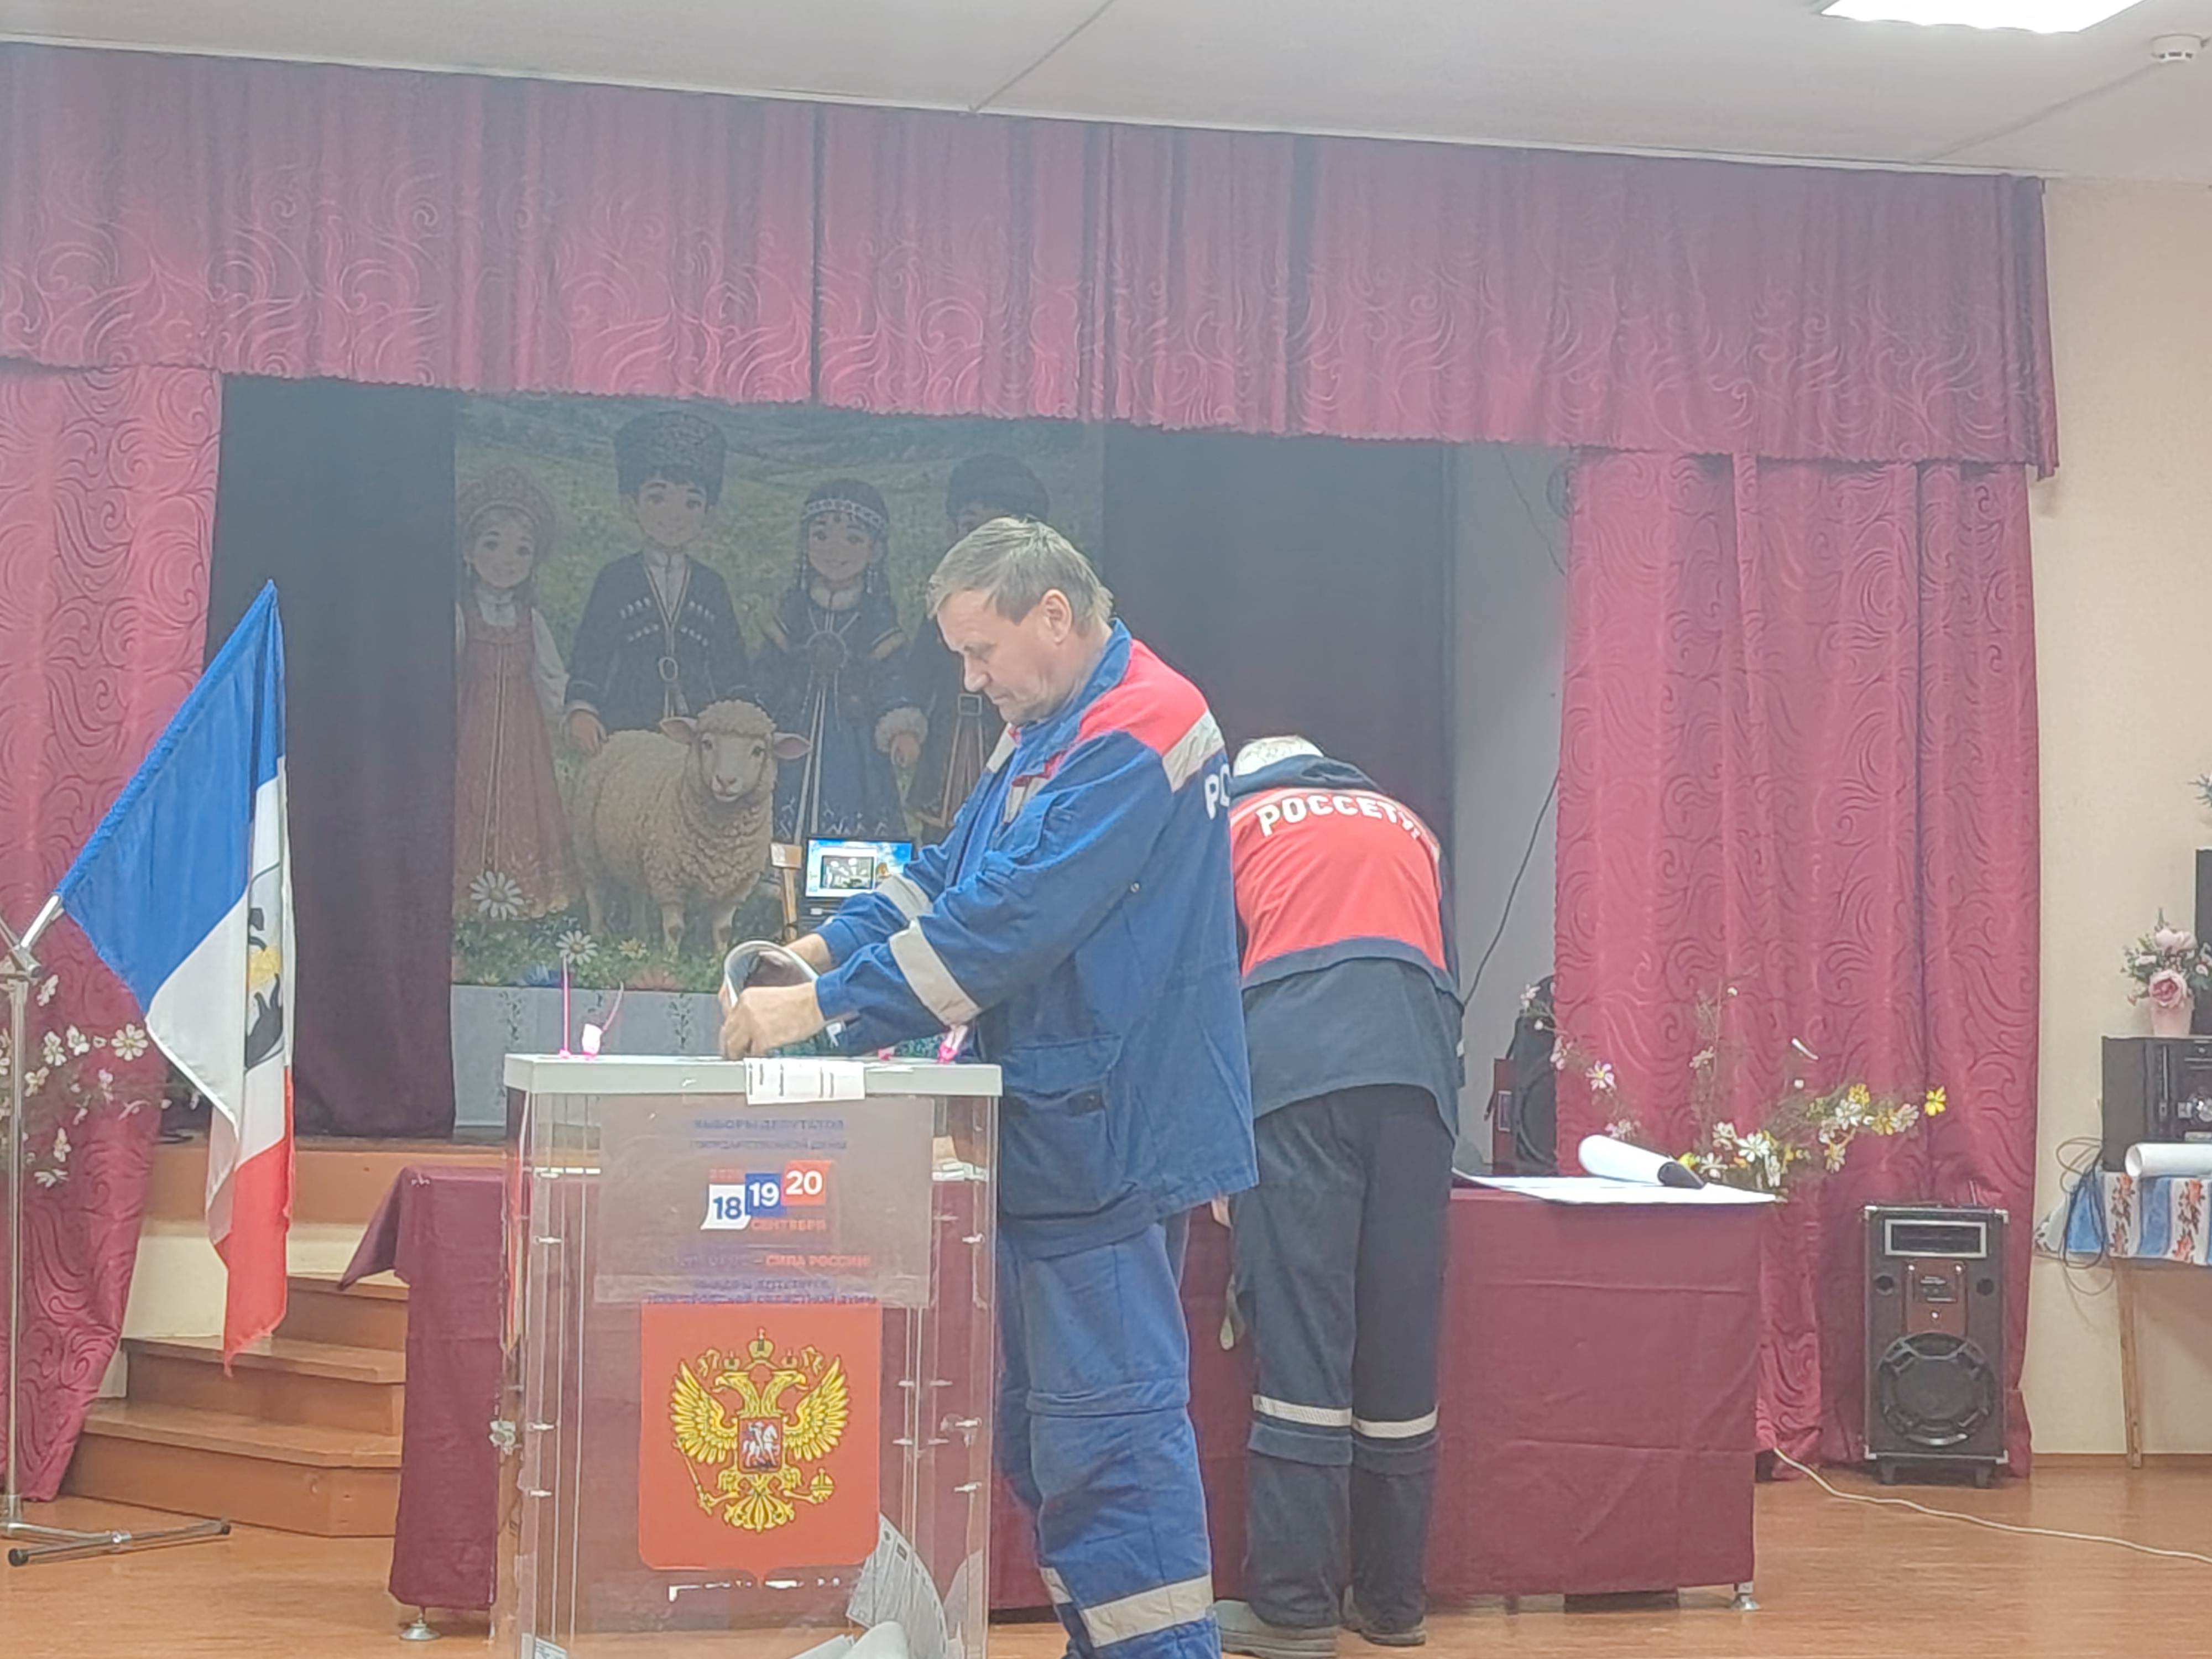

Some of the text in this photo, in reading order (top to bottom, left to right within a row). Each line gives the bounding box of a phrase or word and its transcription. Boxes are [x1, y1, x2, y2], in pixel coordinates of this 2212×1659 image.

[713, 1170, 823, 1220] 18 19 20
